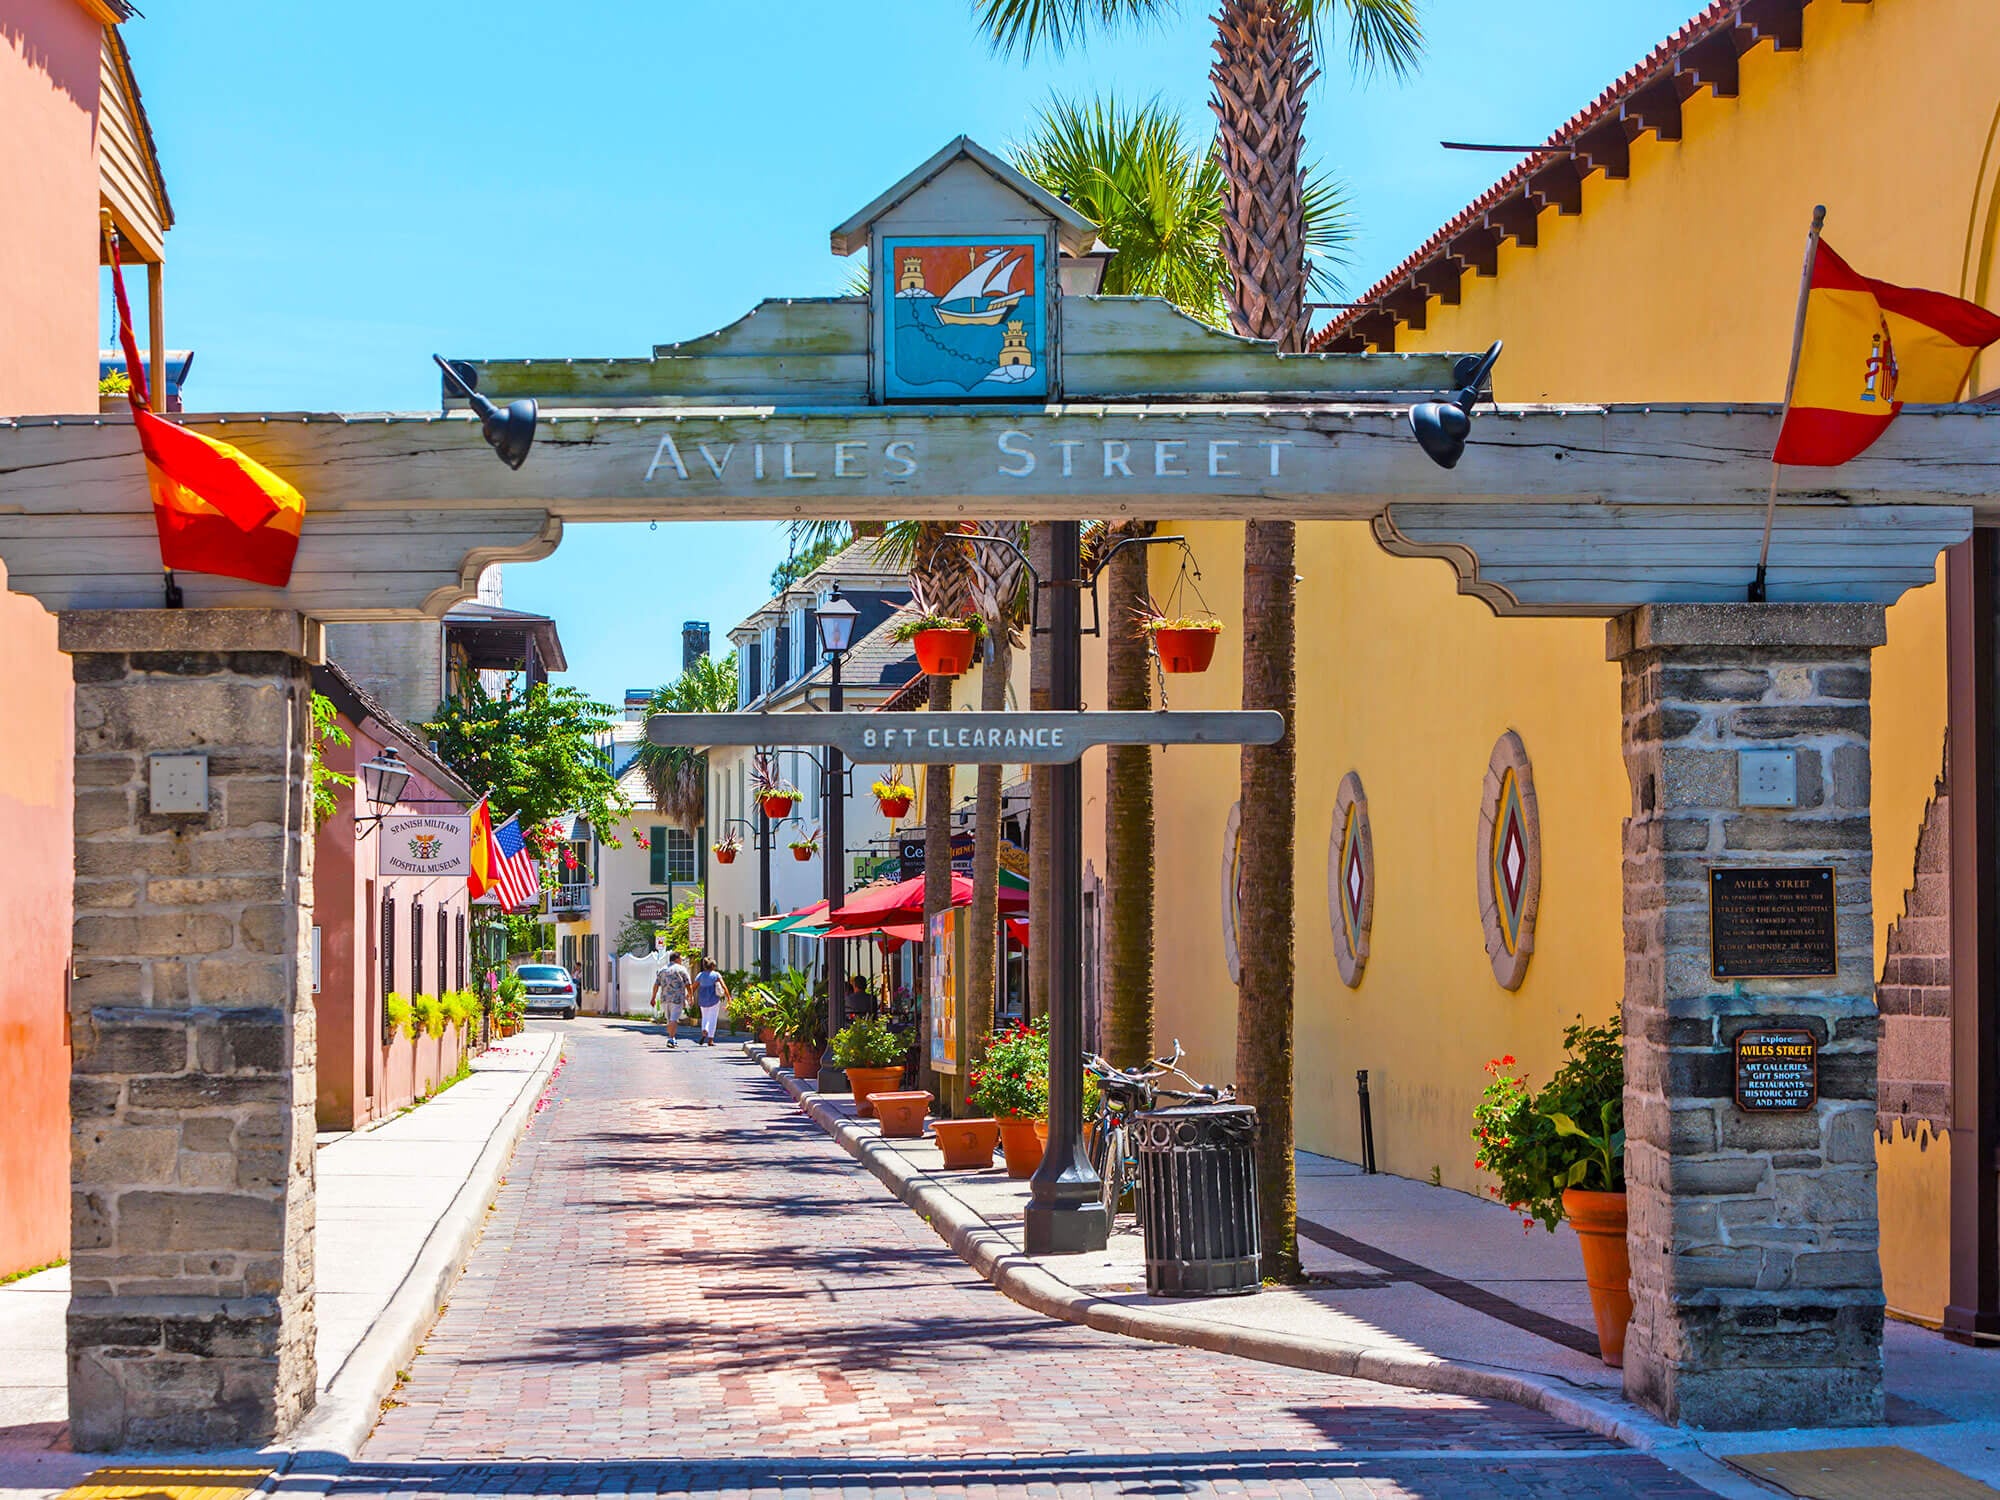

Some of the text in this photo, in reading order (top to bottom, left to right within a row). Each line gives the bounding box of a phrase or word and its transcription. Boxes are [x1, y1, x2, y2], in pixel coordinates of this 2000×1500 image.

[644, 430, 1296, 481] AVILES STREET
[928, 728, 1064, 747] CLEARANCE
[391, 819, 460, 835] SPANISH MILITARY
[389, 857, 461, 873] HOSPITAL MUSEUM
[1775, 880, 1811, 889] STREET
[1760, 1035, 1793, 1044] Explore
[1740, 1045, 1812, 1056] AVILES STREET
[1763, 1063, 1808, 1071] GALLERIES
[1752, 1072, 1801, 1080] GIFT SHOPS
